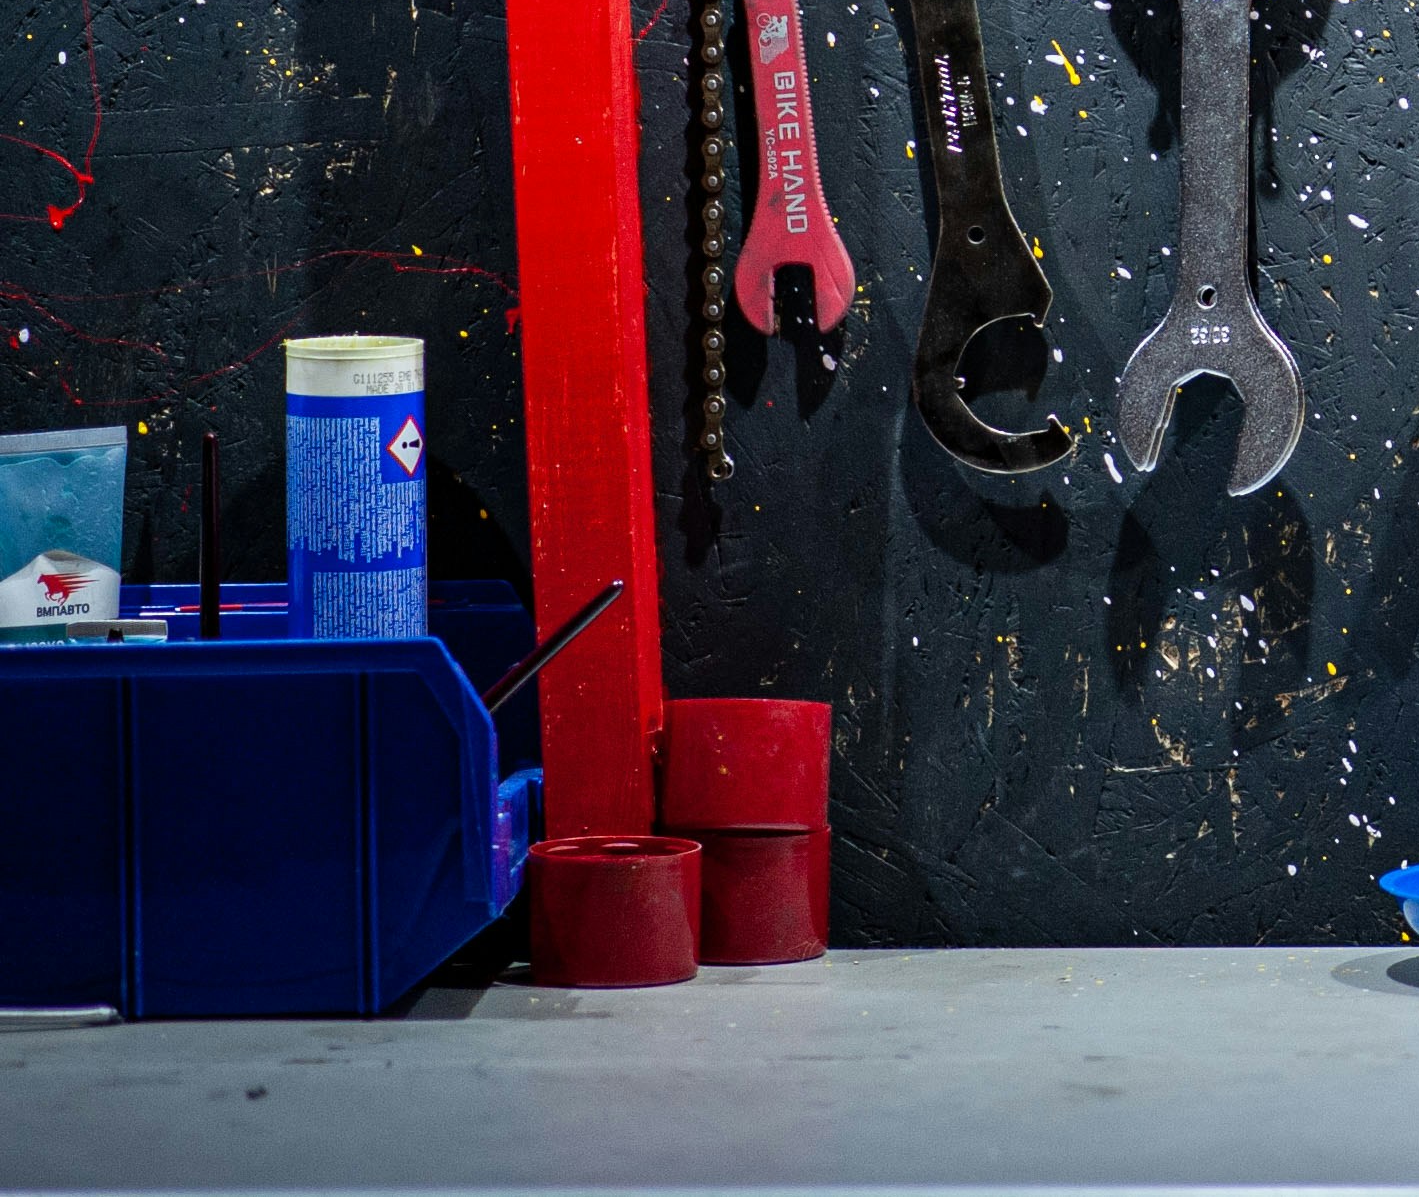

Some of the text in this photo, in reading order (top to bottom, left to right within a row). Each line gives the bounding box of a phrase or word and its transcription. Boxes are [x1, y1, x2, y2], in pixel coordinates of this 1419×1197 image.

[765, 128, 778, 180] YC-502A
[773, 71, 808, 234] BIKE HAND
[36, 603, 90, 618] ВМПАВТО
